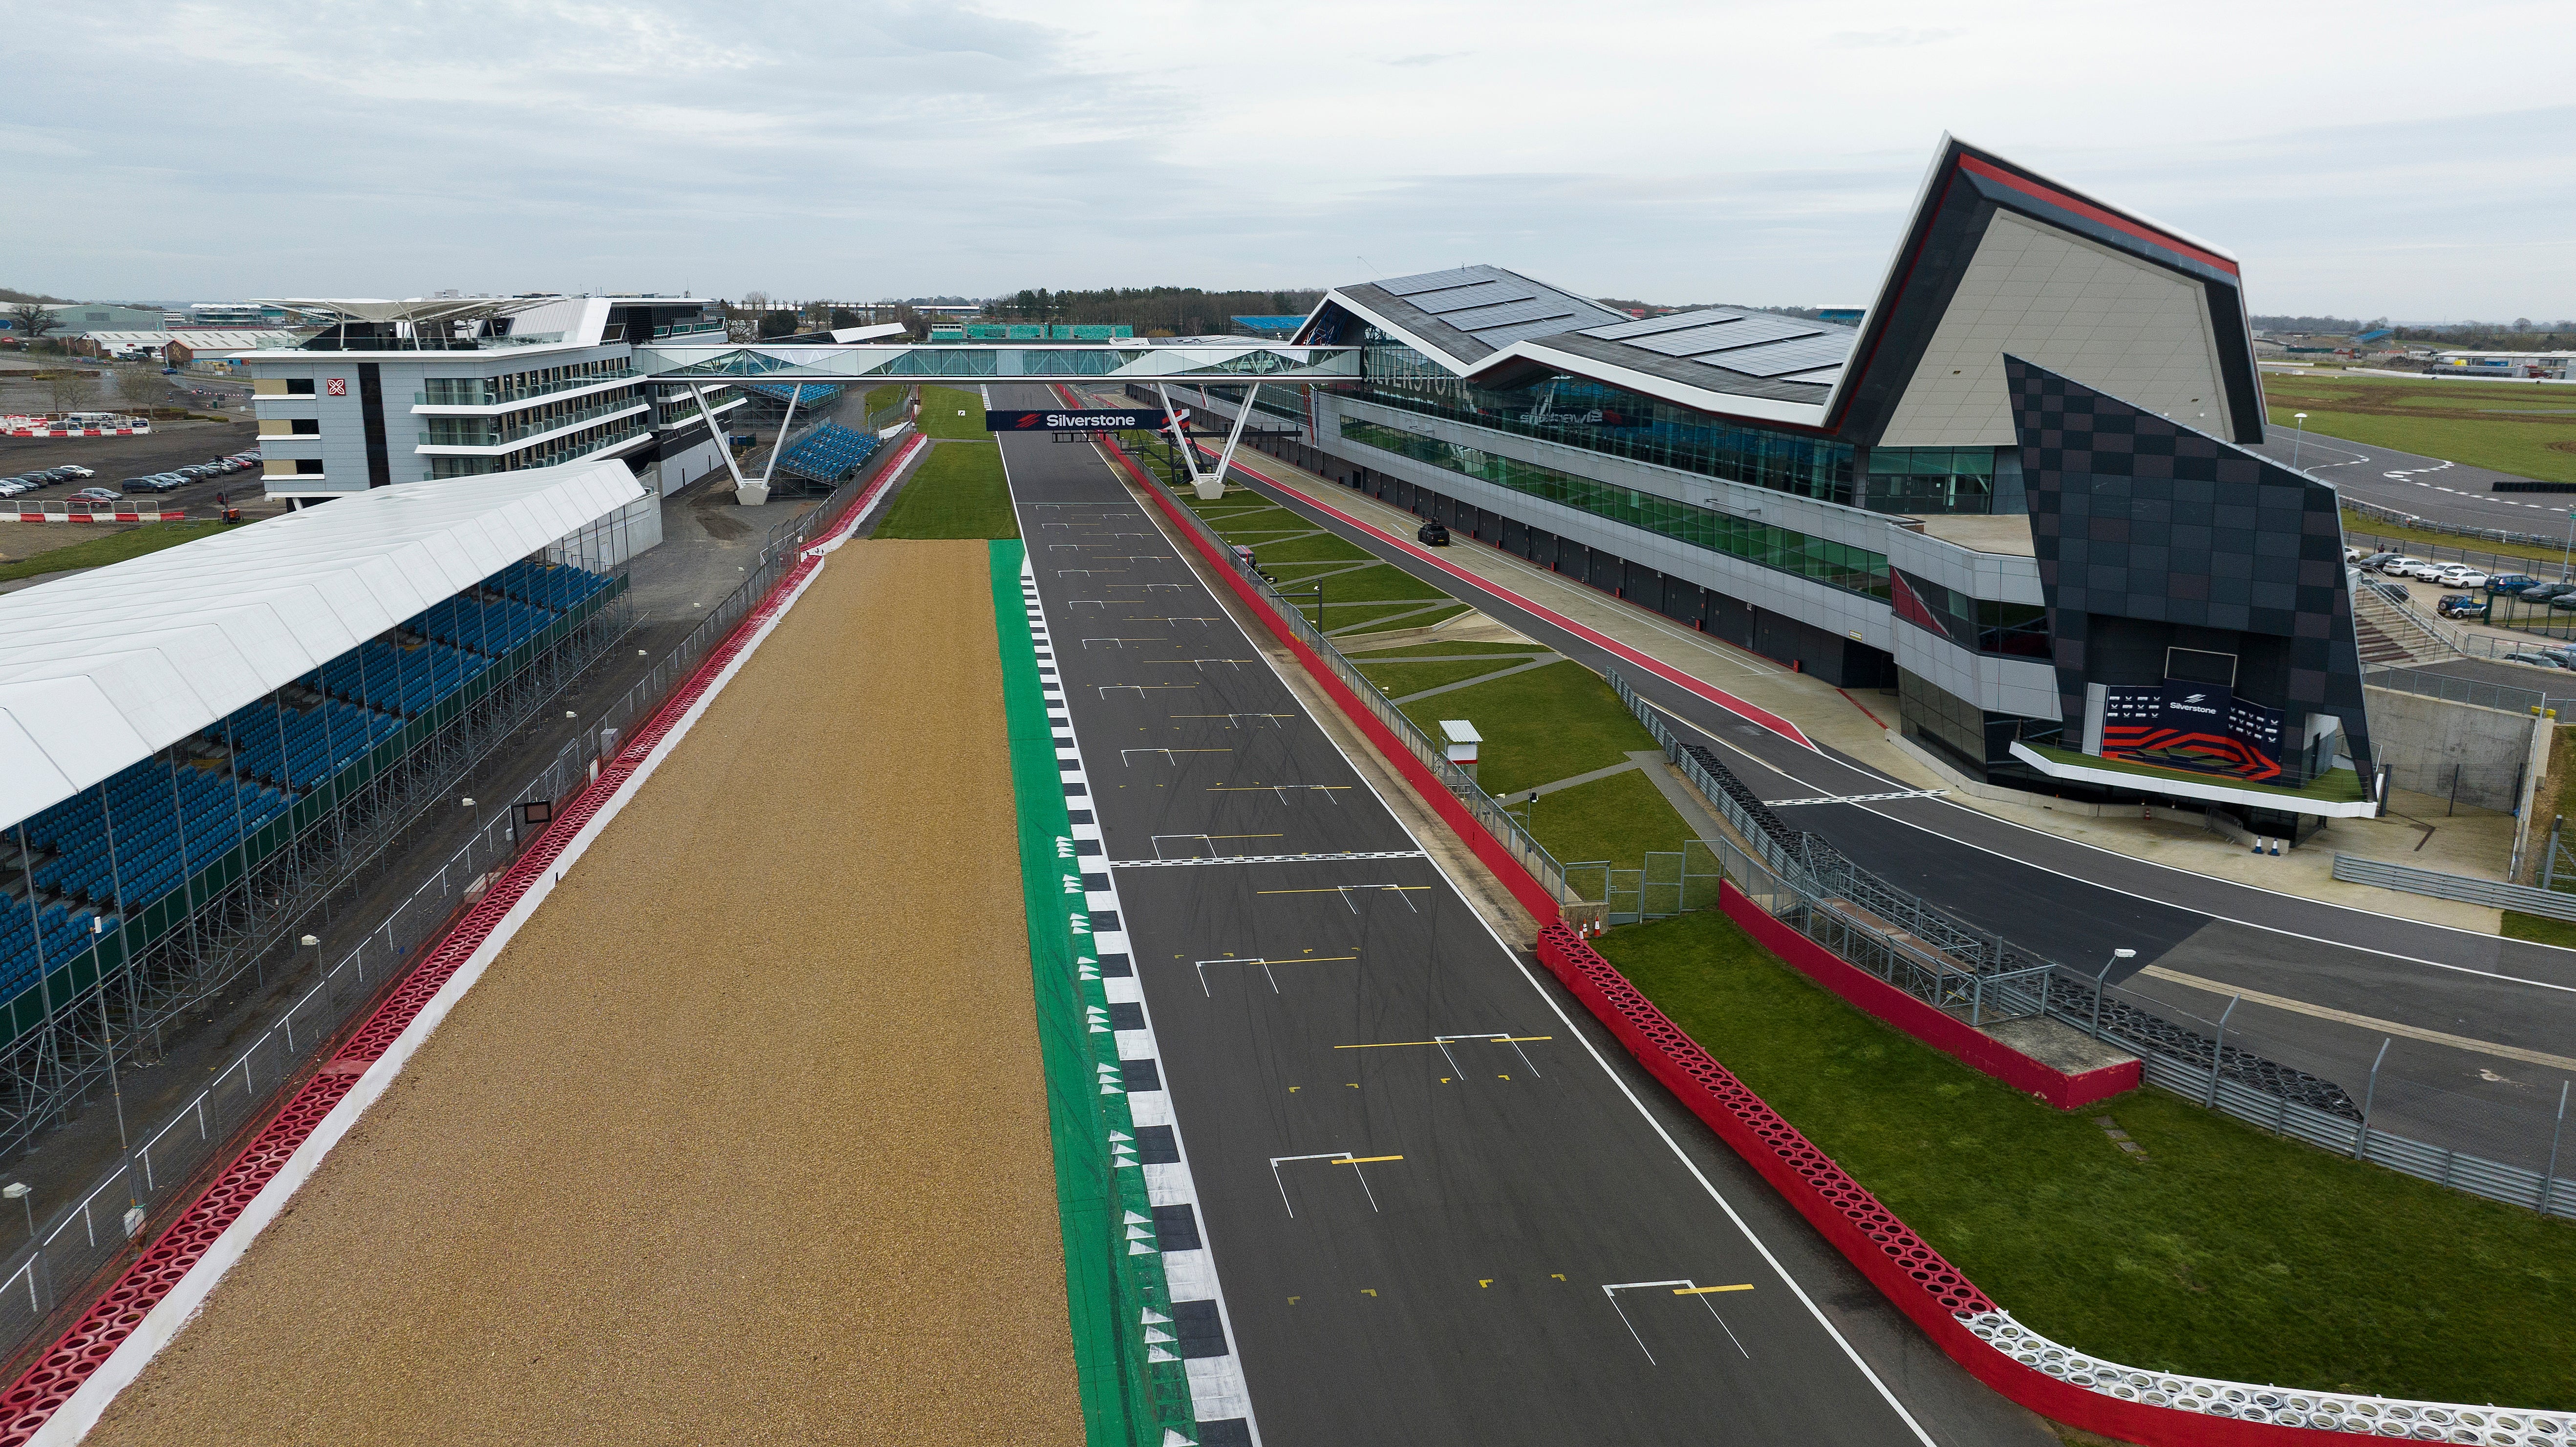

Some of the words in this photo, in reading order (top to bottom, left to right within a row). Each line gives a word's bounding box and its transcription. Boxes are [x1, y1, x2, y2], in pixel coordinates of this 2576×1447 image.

[1047, 414, 1136, 426] Silverstone
[1747, 603, 1752, 611] 02
[2169, 702, 2217, 714] Silverstone
